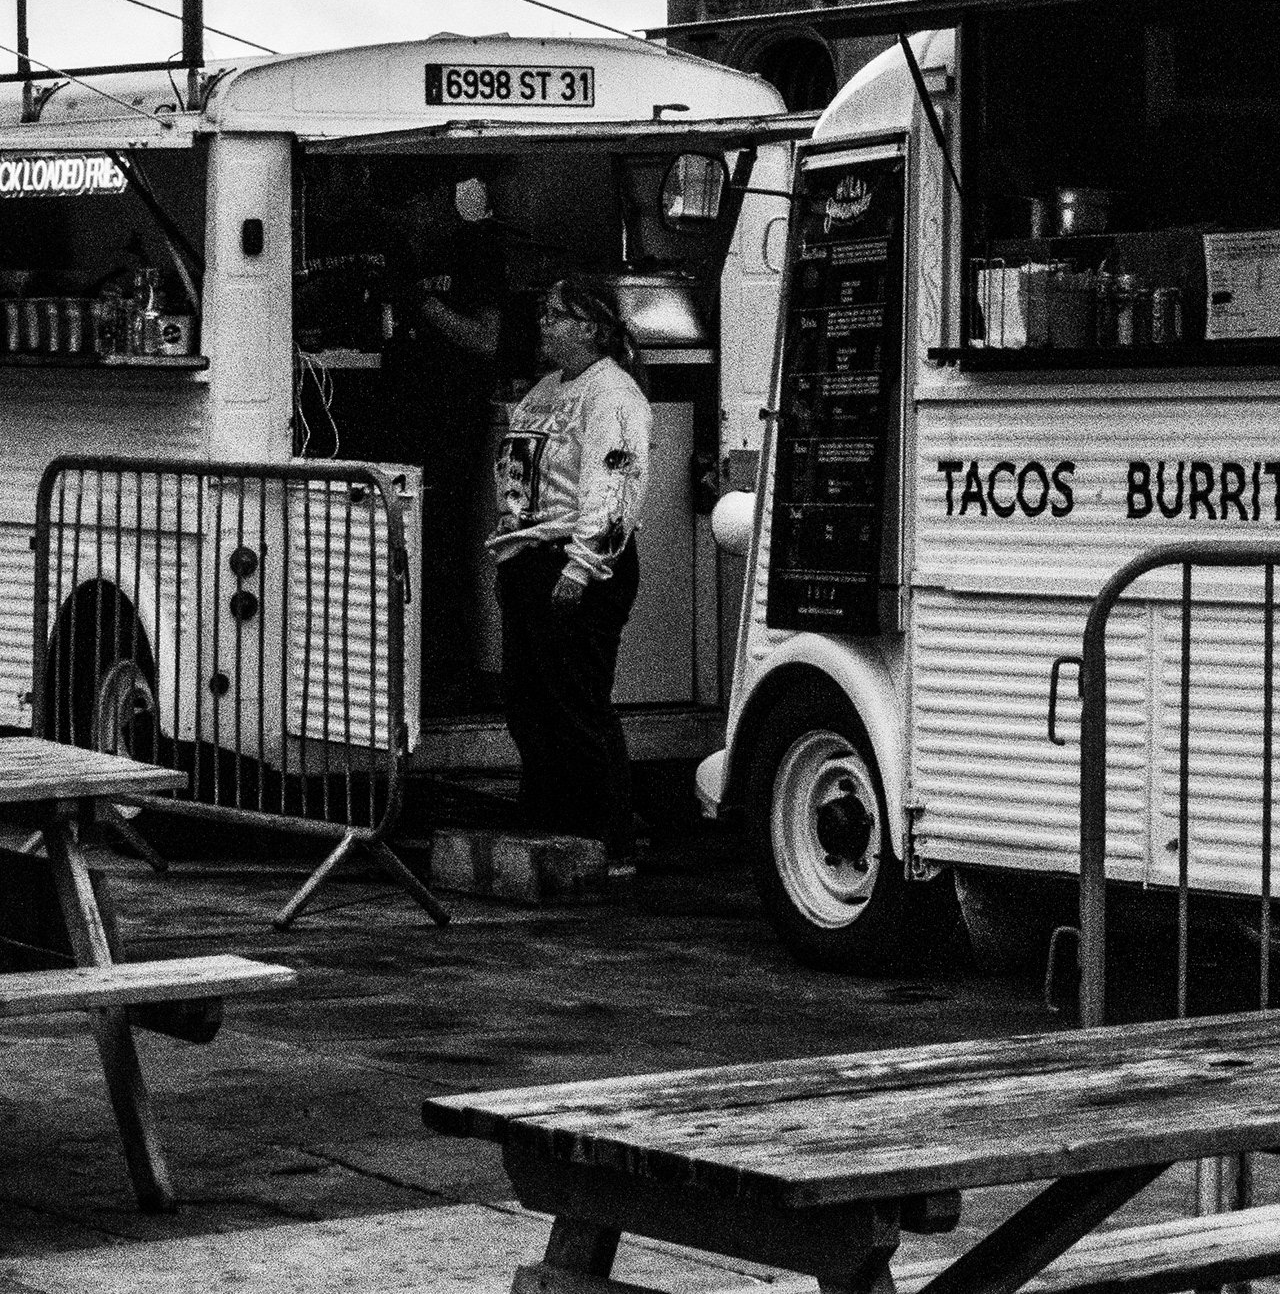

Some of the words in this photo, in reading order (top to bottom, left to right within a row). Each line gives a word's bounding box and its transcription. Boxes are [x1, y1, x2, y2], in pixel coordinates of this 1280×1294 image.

[446, 70, 511, 100] 6998
[520, 72, 551, 100] ST
[561, 73, 588, 101] 31
[23, 158, 83, 190] LOADED
[939, 461, 1075, 518] TACOS
